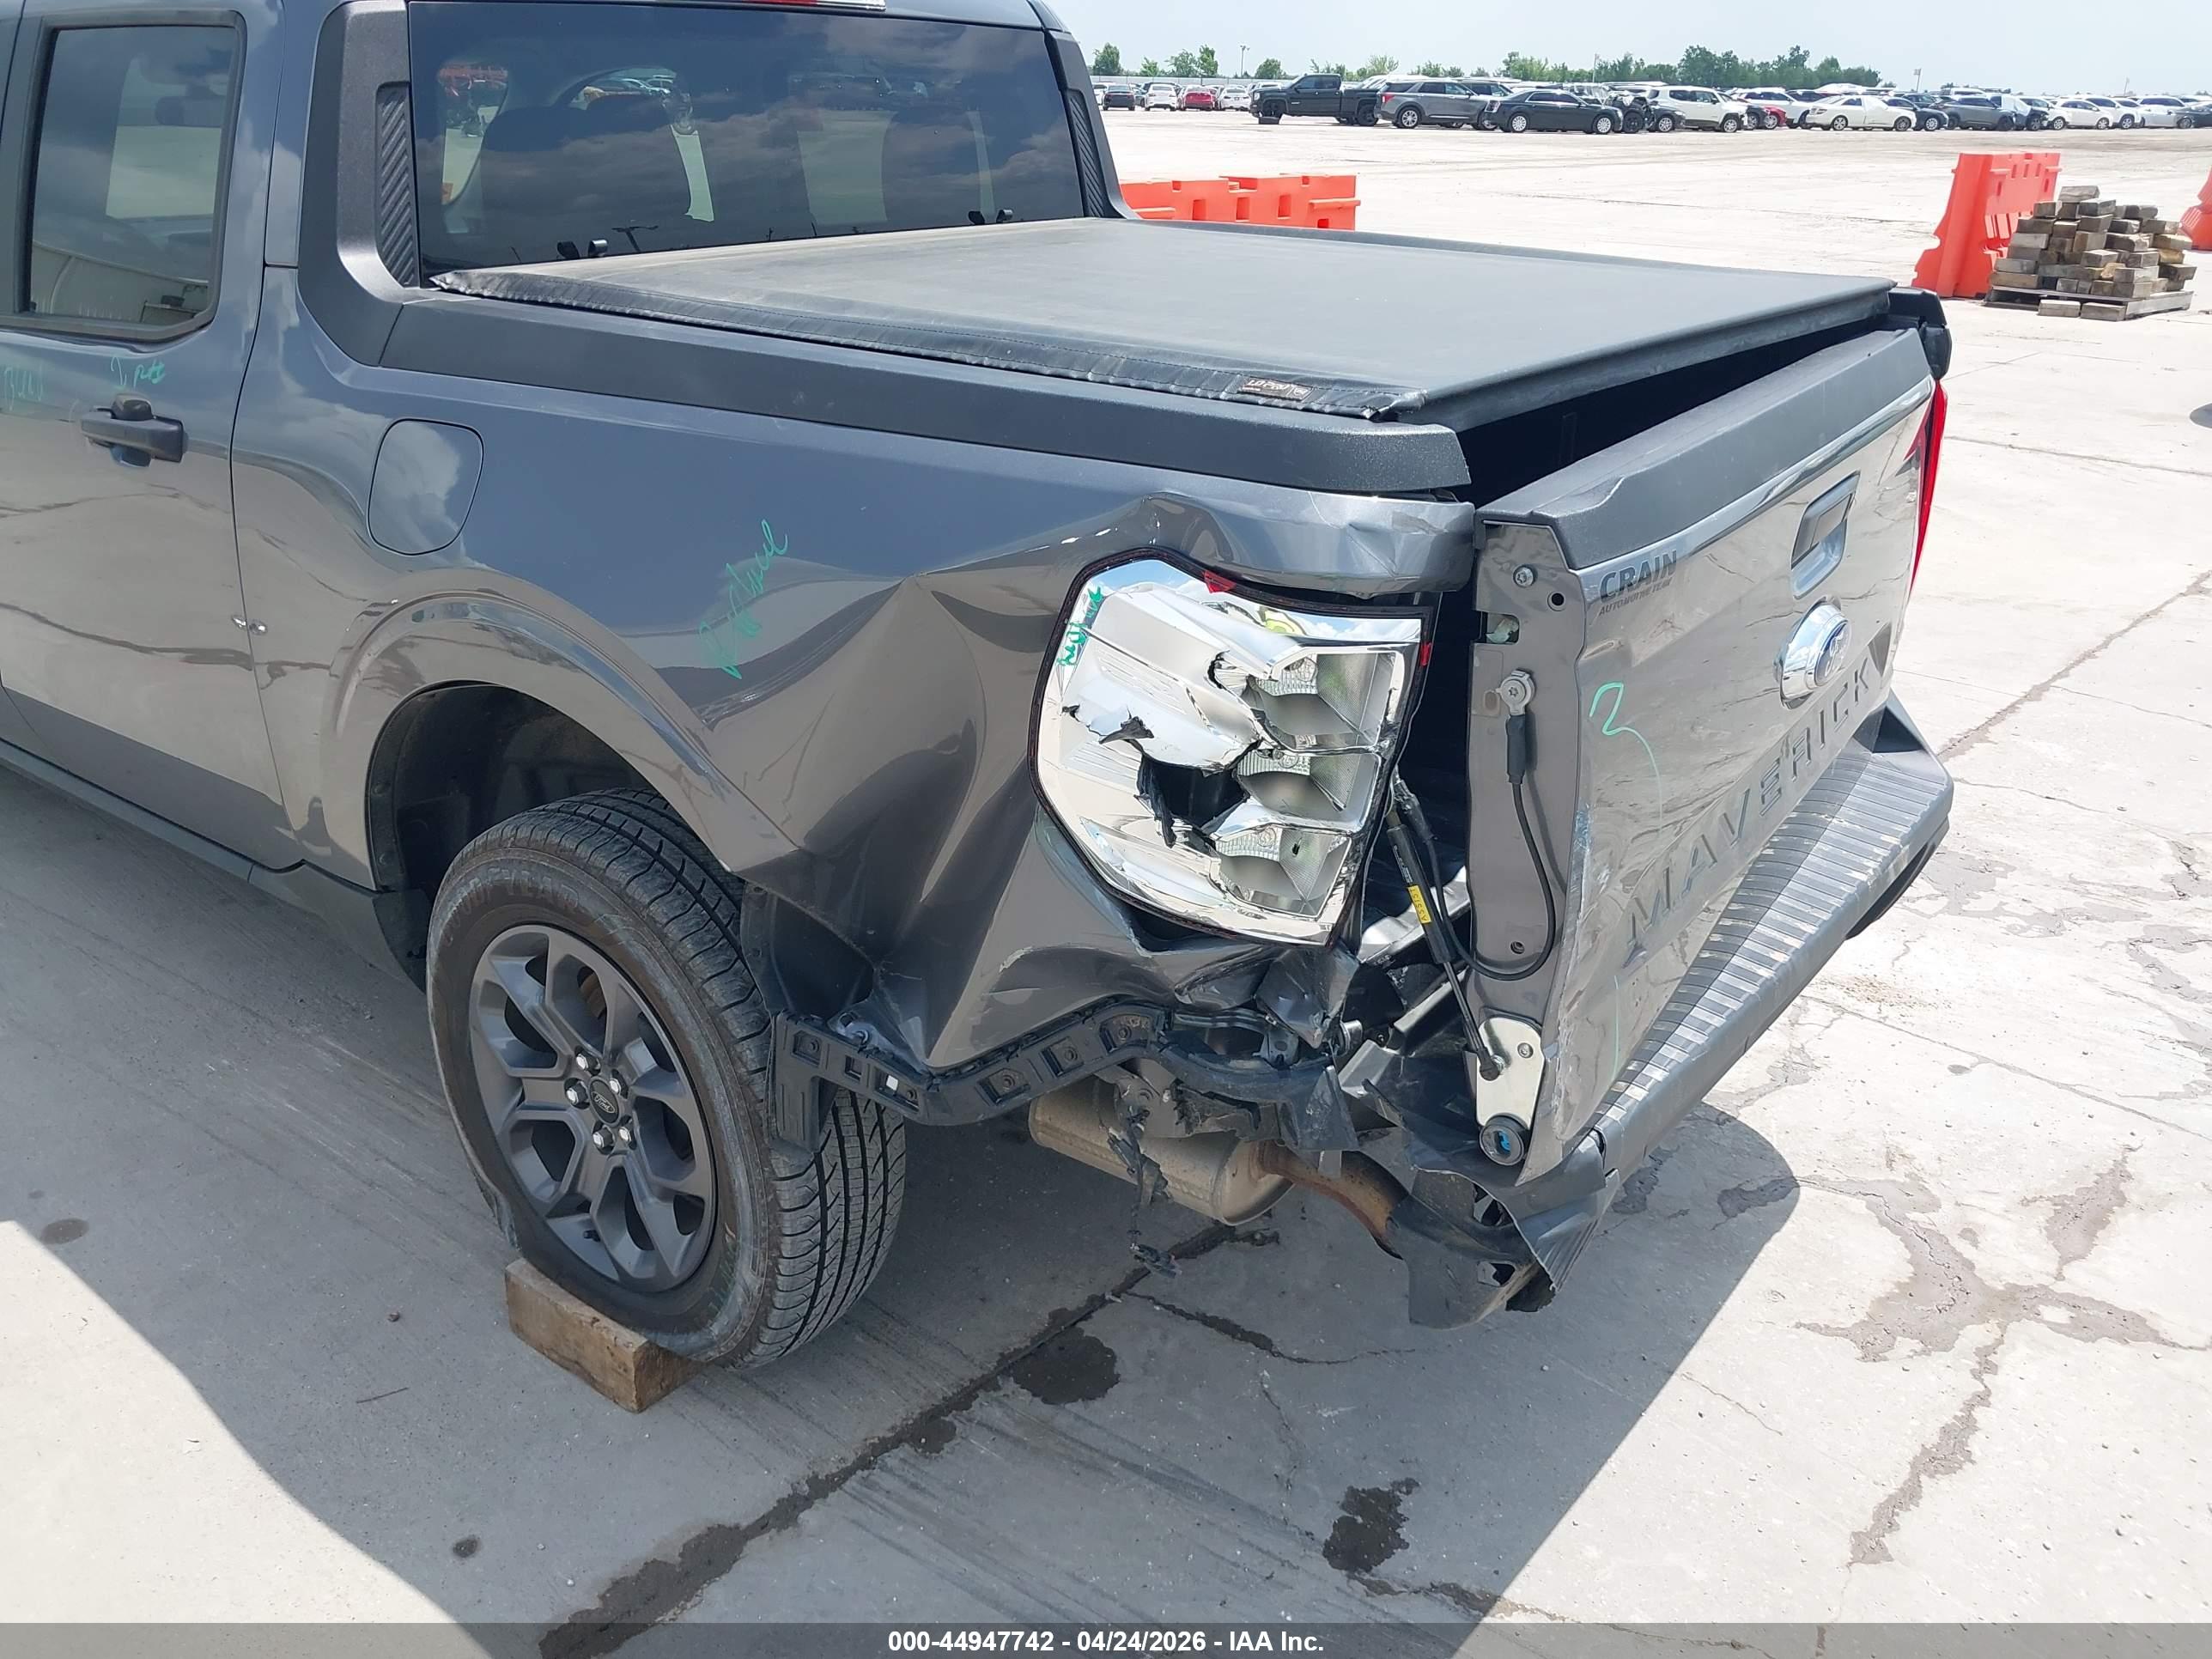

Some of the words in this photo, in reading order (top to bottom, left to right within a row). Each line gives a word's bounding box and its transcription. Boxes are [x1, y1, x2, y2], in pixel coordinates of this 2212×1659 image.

[1600, 550, 1677, 604] CRAIN
[1623, 656, 1869, 969] MAVERICK
[1408, 887, 1429, 922] ASSIST
